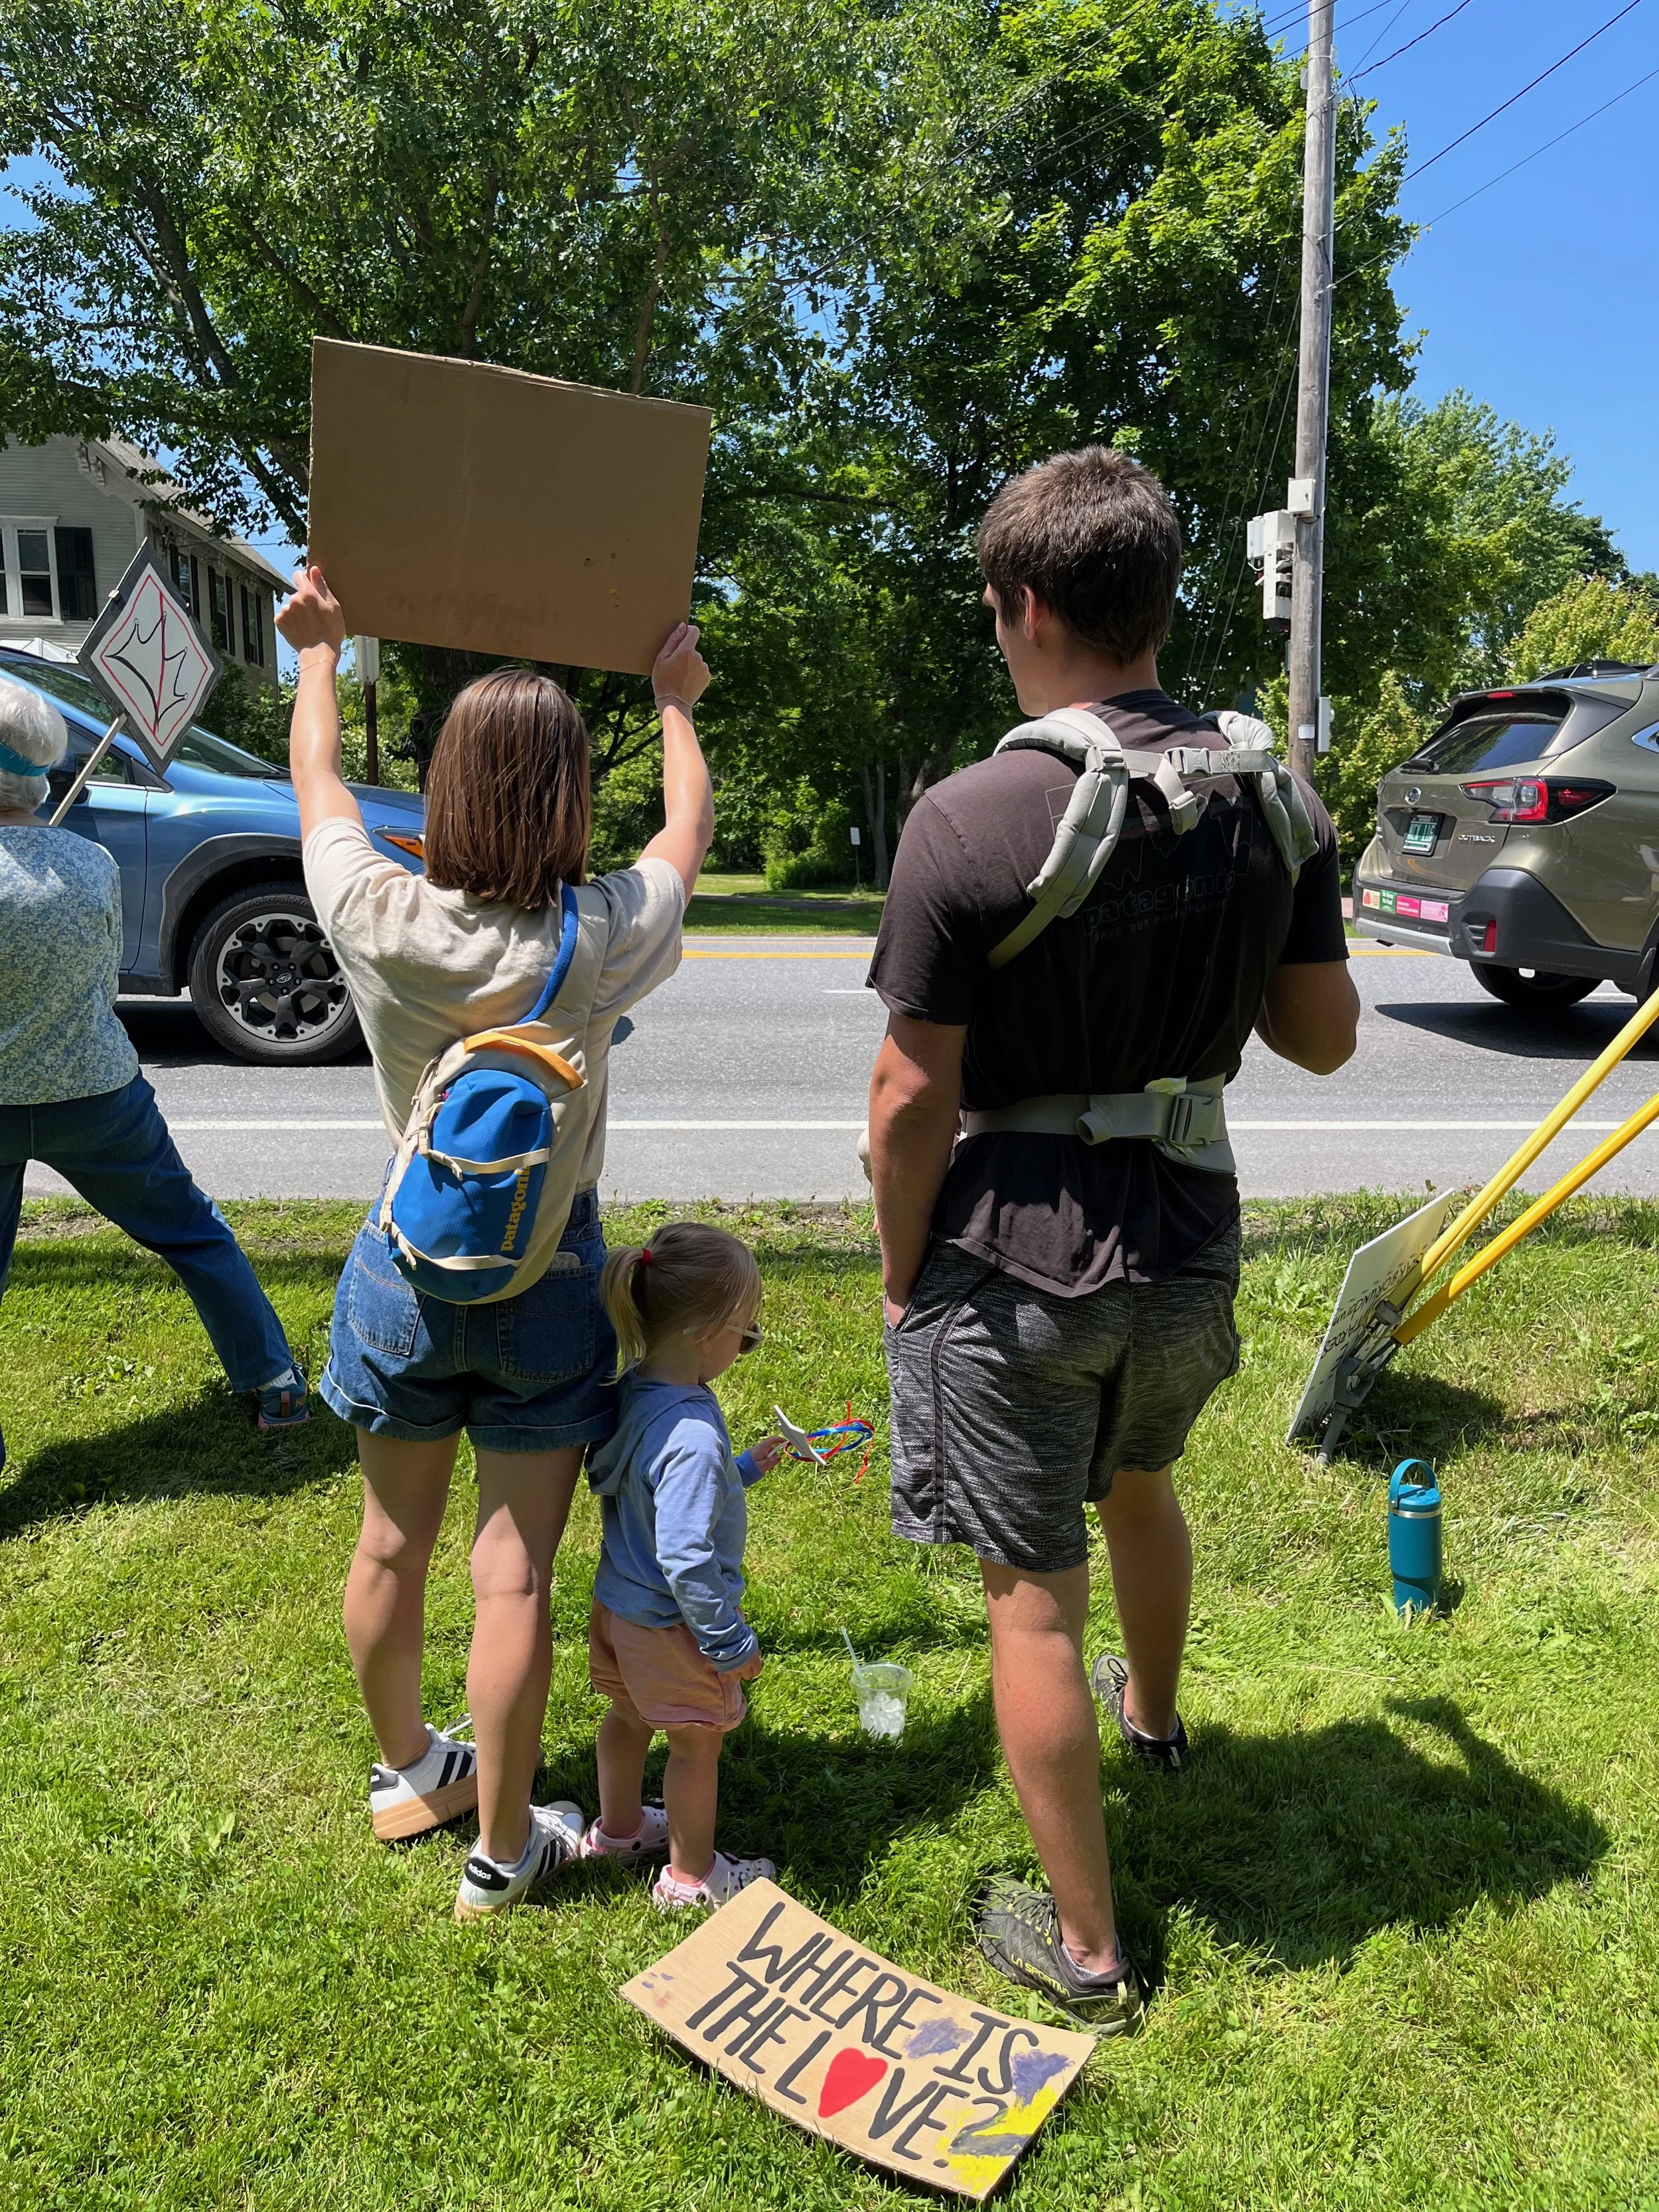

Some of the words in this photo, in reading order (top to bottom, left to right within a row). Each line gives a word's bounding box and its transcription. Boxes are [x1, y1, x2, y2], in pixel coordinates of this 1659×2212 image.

[1459, 834, 1495, 843] OUTBACK
[244, 895, 311, 910] YOKOHA
[1081, 866, 1236, 936] patagonia
[1094, 927, 1122, 942] SAVE
[1130, 919, 1149, 932] OUR
[500, 1166, 531, 1252] patagoni
[468, 1862, 492, 1880] adidas
[737, 1901, 942, 2061] WHERE
[932, 2011, 1039, 2095] IS
[1011, 1953, 1023, 1968] LA
[1024, 1962, 1071, 1998] SPORTIVA
[685, 1961, 811, 2075] THE
